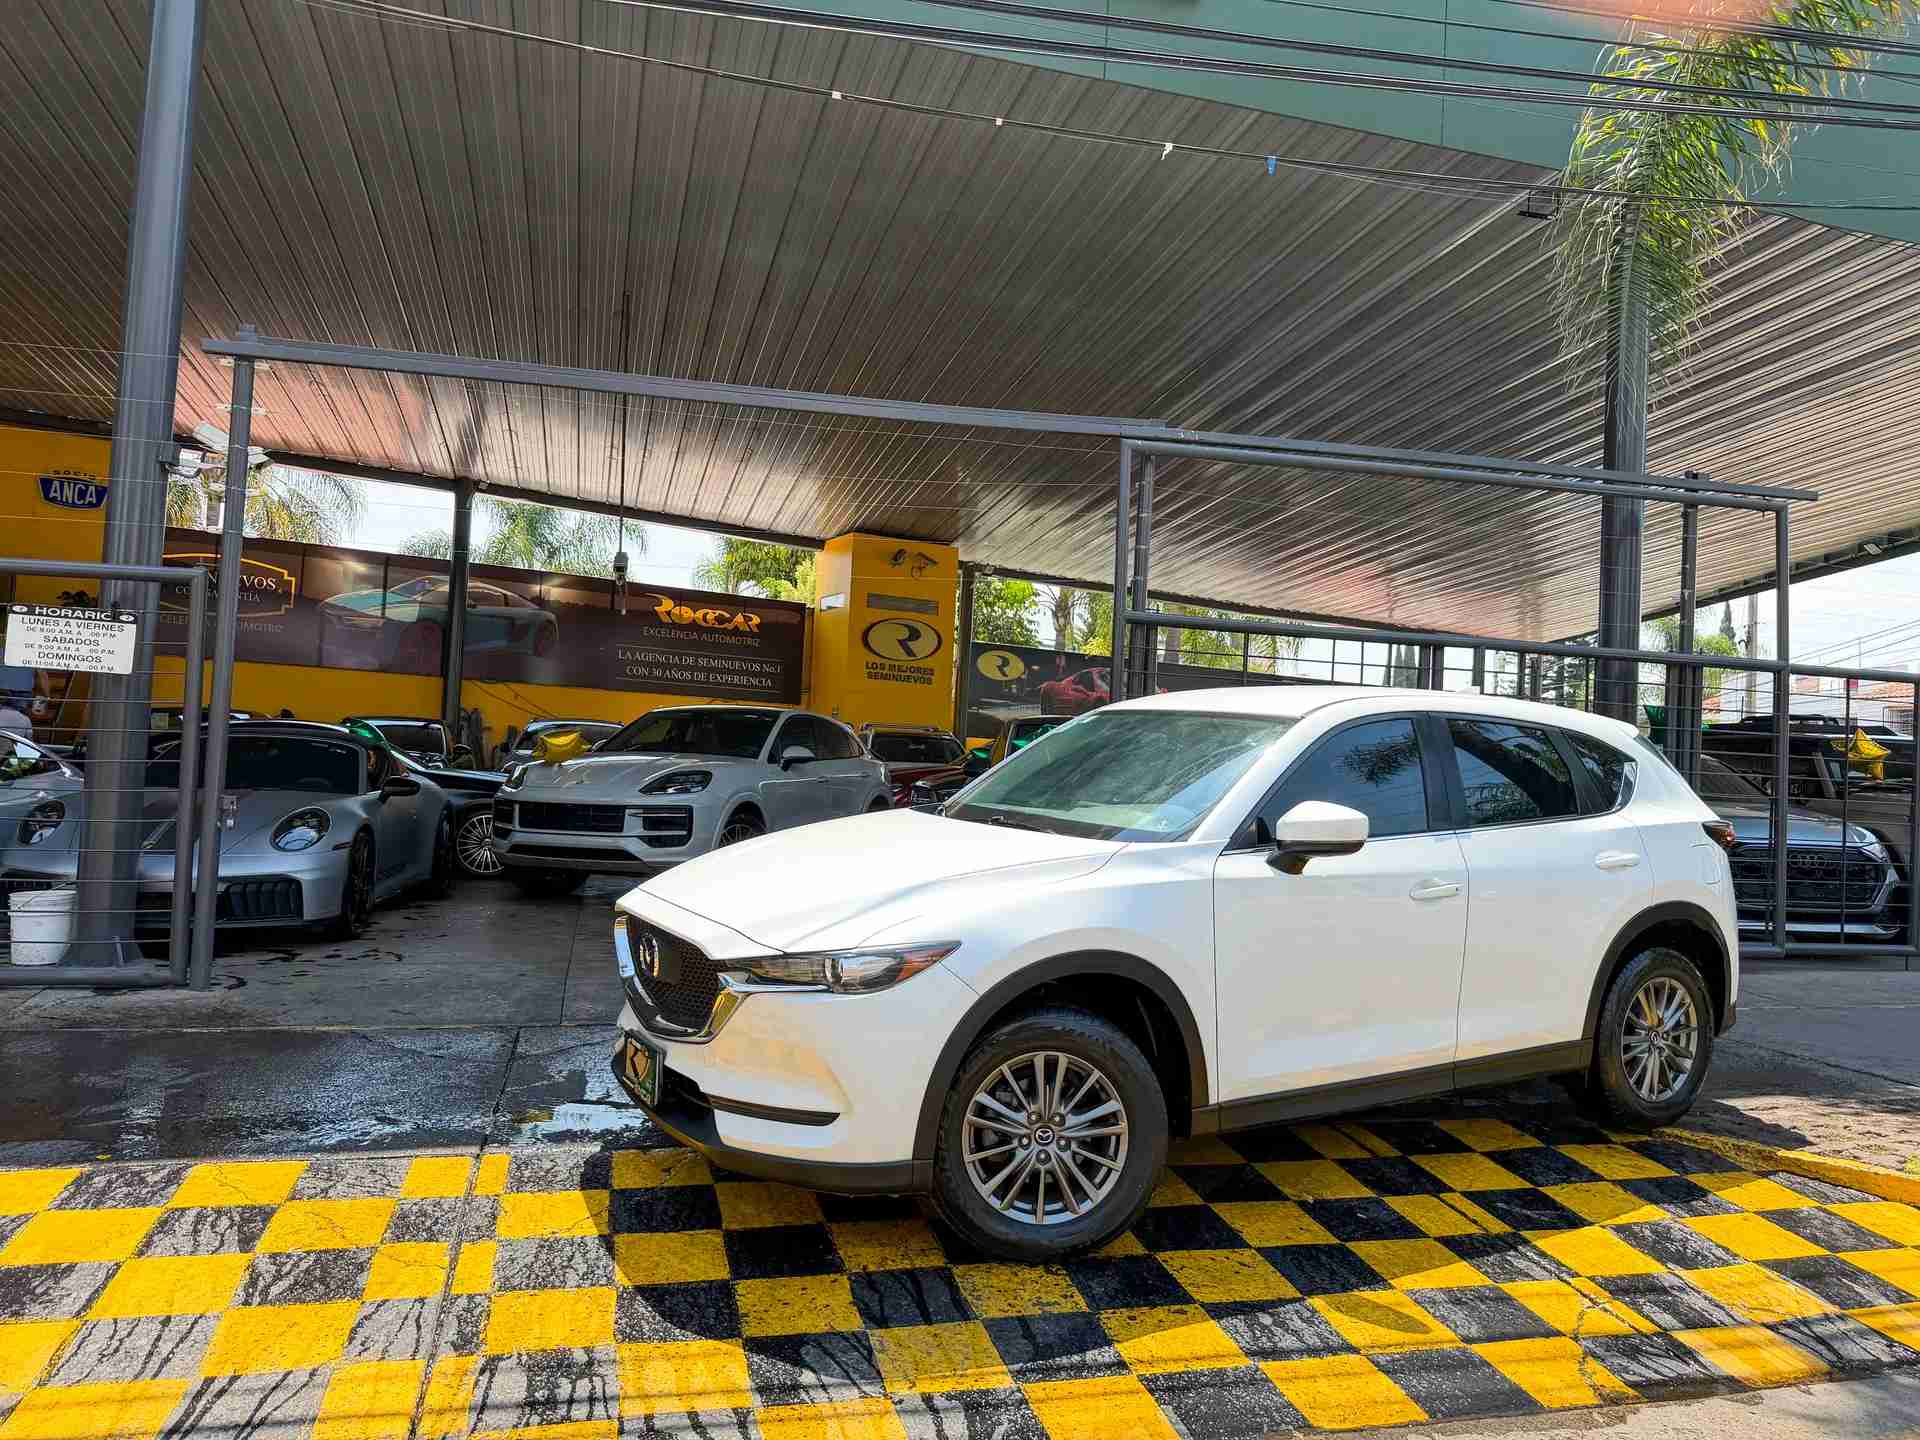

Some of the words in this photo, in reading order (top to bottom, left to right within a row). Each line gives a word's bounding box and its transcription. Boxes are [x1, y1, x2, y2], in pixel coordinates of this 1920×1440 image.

[49, 480, 97, 505] ANCA
[21, 616, 60, 628] LUNES
[64, 620, 72, 629] A
[76, 621, 125, 633] VIERNES
[43, 635, 100, 648] SABADOS
[643, 626, 699, 641] EXCELENCIA
[701, 632, 761, 648] AUTOMOTRIZ
[37, 652, 103, 664] DOMINGOS
[618, 650, 632, 661] LA
[633, 652, 680, 666] AGENCIA
[682, 656, 696, 666] DE
[698, 656, 761, 673] SEMINUEVOS
[626, 665, 649, 677] CON
[664, 667, 692, 681] AÑOS
[694, 672, 708, 682] DE
[709, 673, 772, 688] EXPERIENCIA
[865, 662, 886, 671] LOS
[888, 664, 935, 676] MEJORES
[866, 671, 933, 685] SEMINUEVOS
